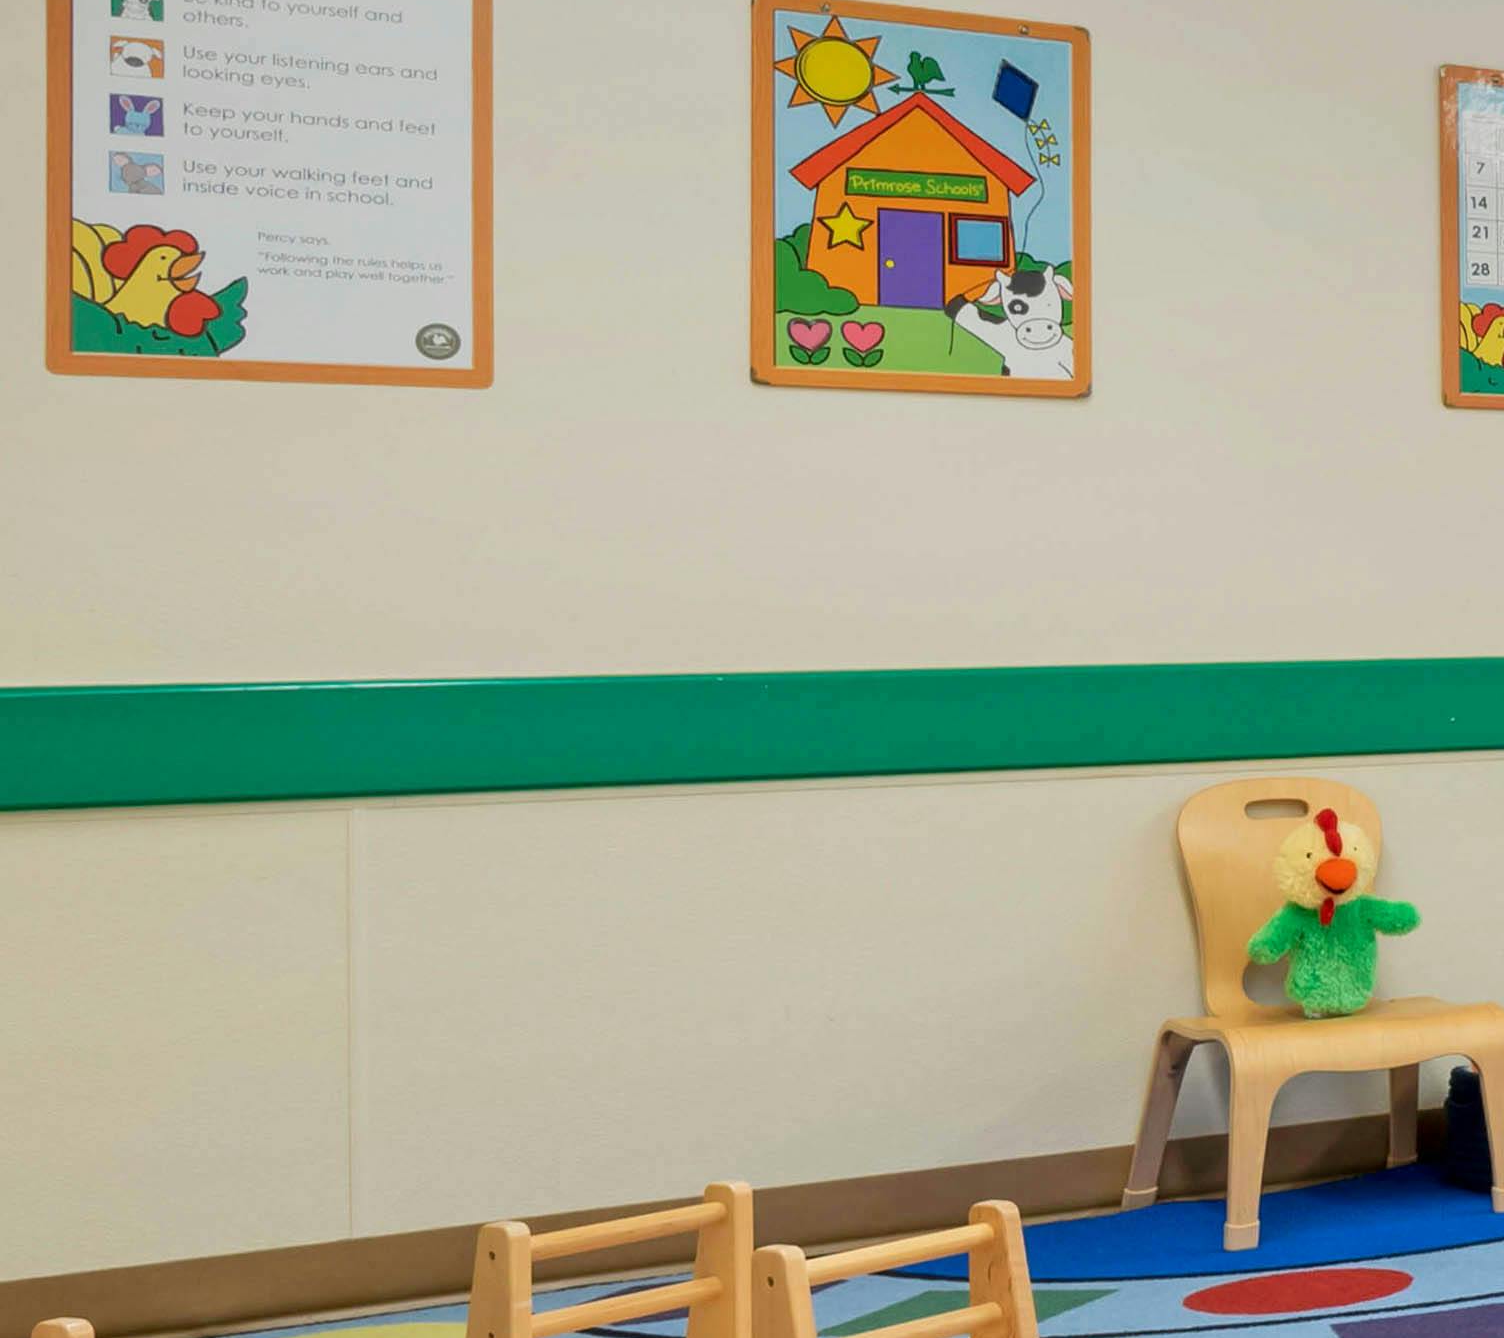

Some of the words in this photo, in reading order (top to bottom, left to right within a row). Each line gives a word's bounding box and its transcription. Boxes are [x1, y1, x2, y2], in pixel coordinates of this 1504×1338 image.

[183, 10, 249, 28] others.
[287, 1, 359, 19] yourself
[365, 10, 403, 24] and
[183, 45, 218, 61] Use
[224, 52, 267, 66] your
[272, 52, 349, 75] listening
[355, 63, 395, 77] ears
[400, 67, 438, 81] and
[183, 64, 254, 86] looking
[261, 75, 310, 90] eyes.
[183, 102, 235, 121] Keep
[241, 109, 284, 123] your
[290, 111, 349, 129] hands
[355, 117, 393, 132] and
[399, 119, 435, 136] feet
[183, 122, 203, 136] to
[209, 125, 288, 143] yourself.
[183, 160, 217, 175] Use
[224, 164, 265, 178] your
[272, 167, 345, 187] walking
[352, 170, 389, 187] feet
[395, 176, 433, 190] and
[1476, 162, 1485, 175] 7
[182, 178, 239, 195] inside
[245, 184, 299, 199] voice
[305, 187, 321, 200] in
[327, 190, 394, 206] school.
[850, 175, 921, 193] Primrose
[1471, 196, 1488, 210] 14
[257, 231, 297, 245] Percy
[1472, 225, 1489, 240] 21
[332, 255, 354, 266] the
[1471, 263, 1490, 276] 28
[294, 268, 322, 278] and
[325, 269, 354, 282] play
